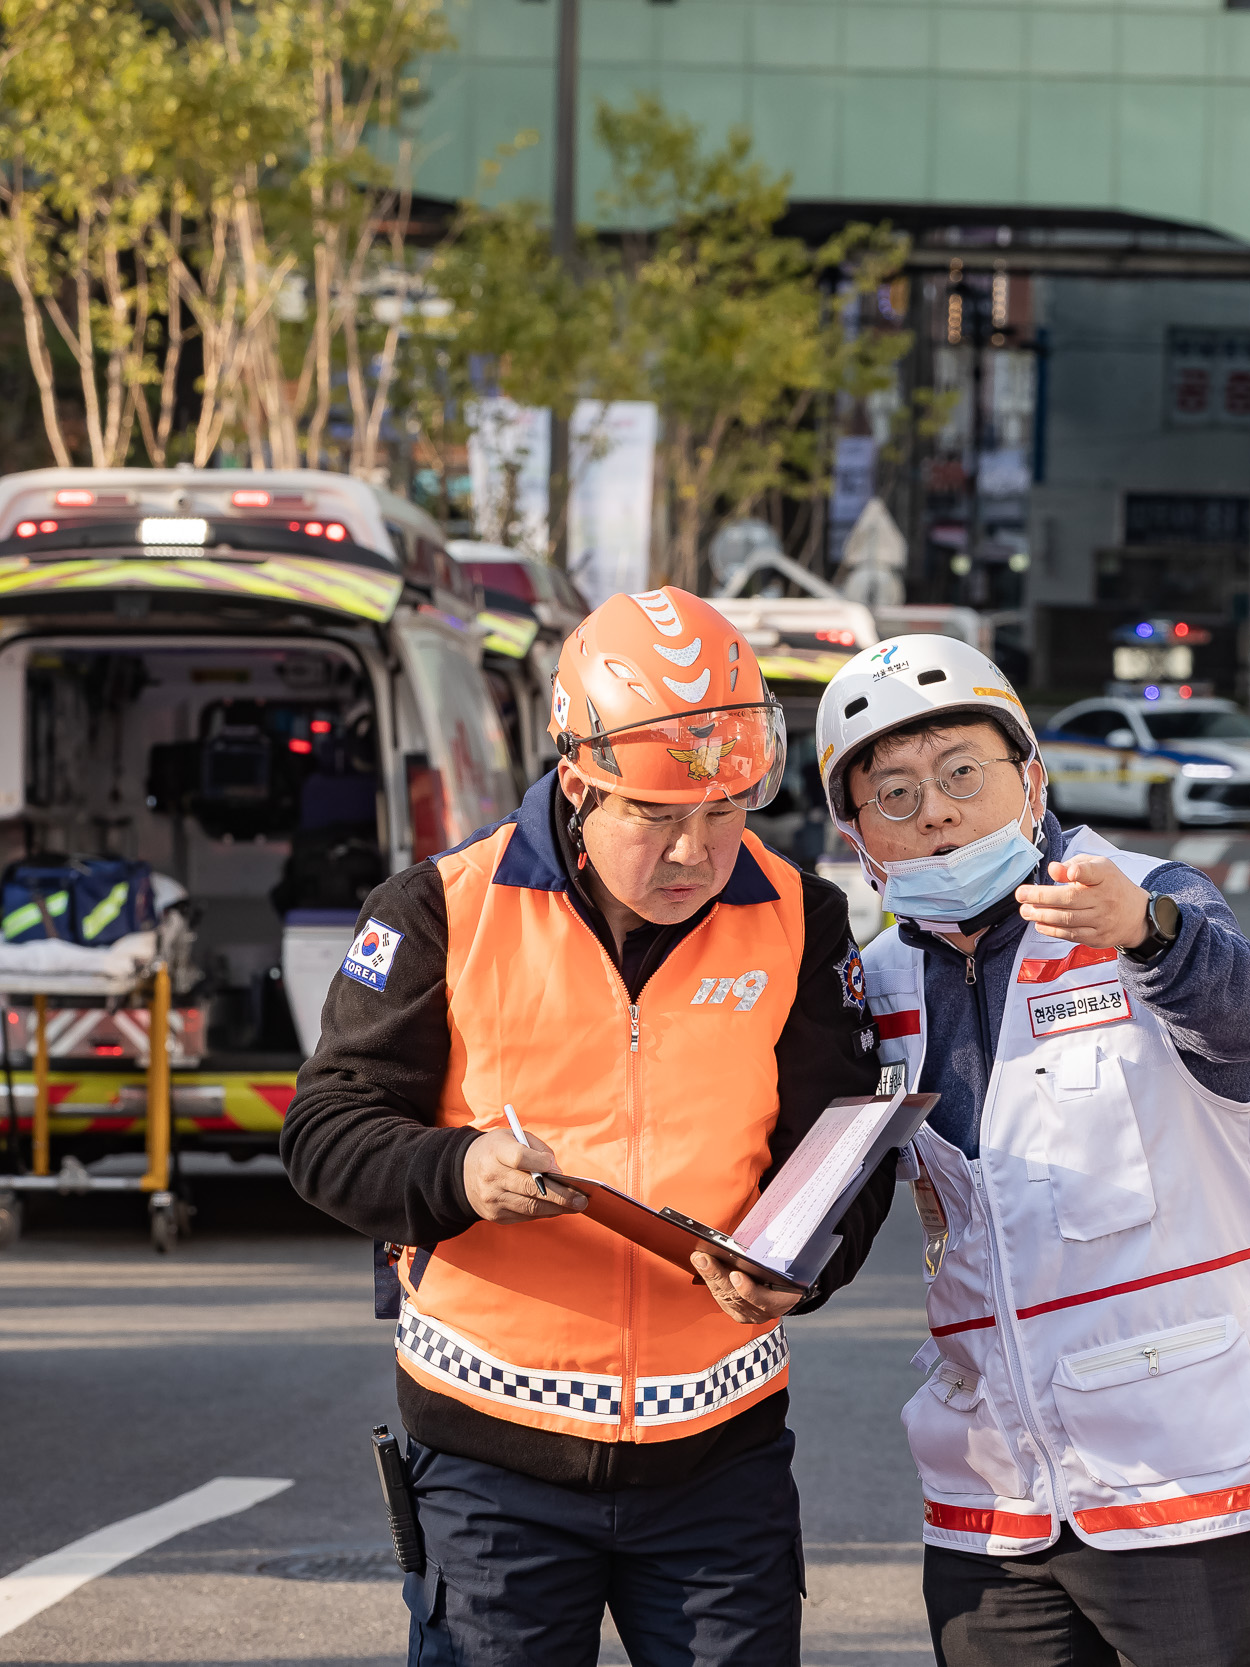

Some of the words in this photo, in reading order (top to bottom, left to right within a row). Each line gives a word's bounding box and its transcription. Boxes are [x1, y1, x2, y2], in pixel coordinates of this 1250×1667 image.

[872, 660, 909, 679] 서울특별시
[344, 959, 377, 984] KOREA
[690, 969, 769, 1012] 119
[1033, 991, 1122, 1025] 현장응급의료소장
